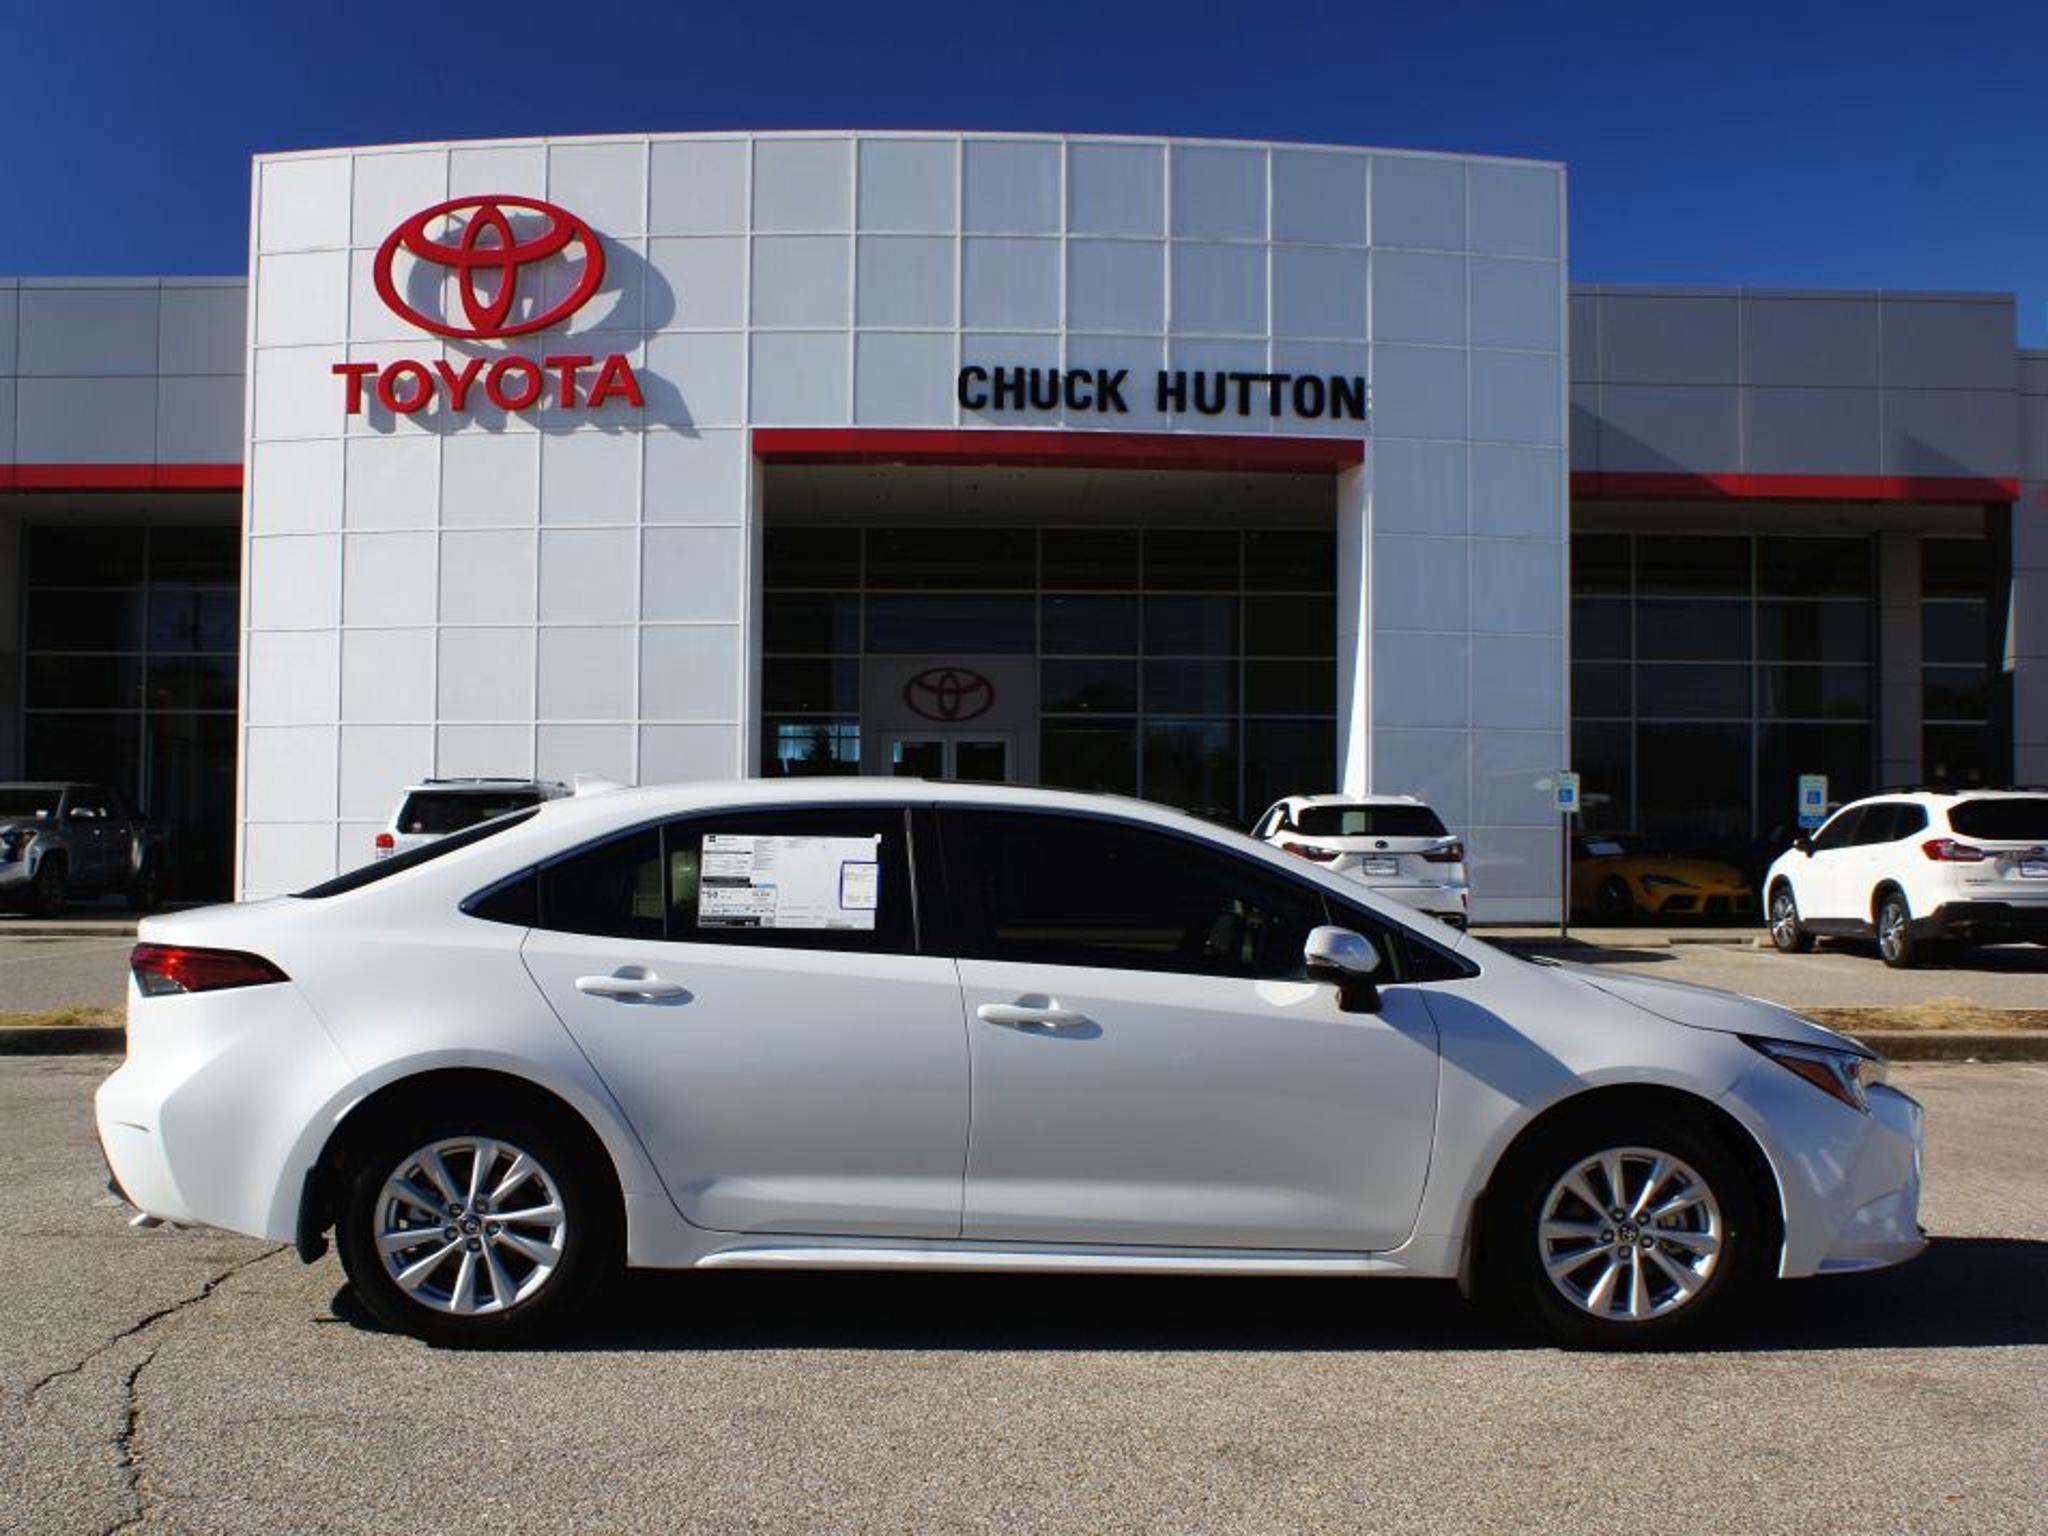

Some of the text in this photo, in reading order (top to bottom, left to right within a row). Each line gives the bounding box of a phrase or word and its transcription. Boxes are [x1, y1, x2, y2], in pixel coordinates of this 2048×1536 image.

[332, 353, 645, 415] TOYOTA
[957, 365, 1366, 420] CHUCK HUTTON
